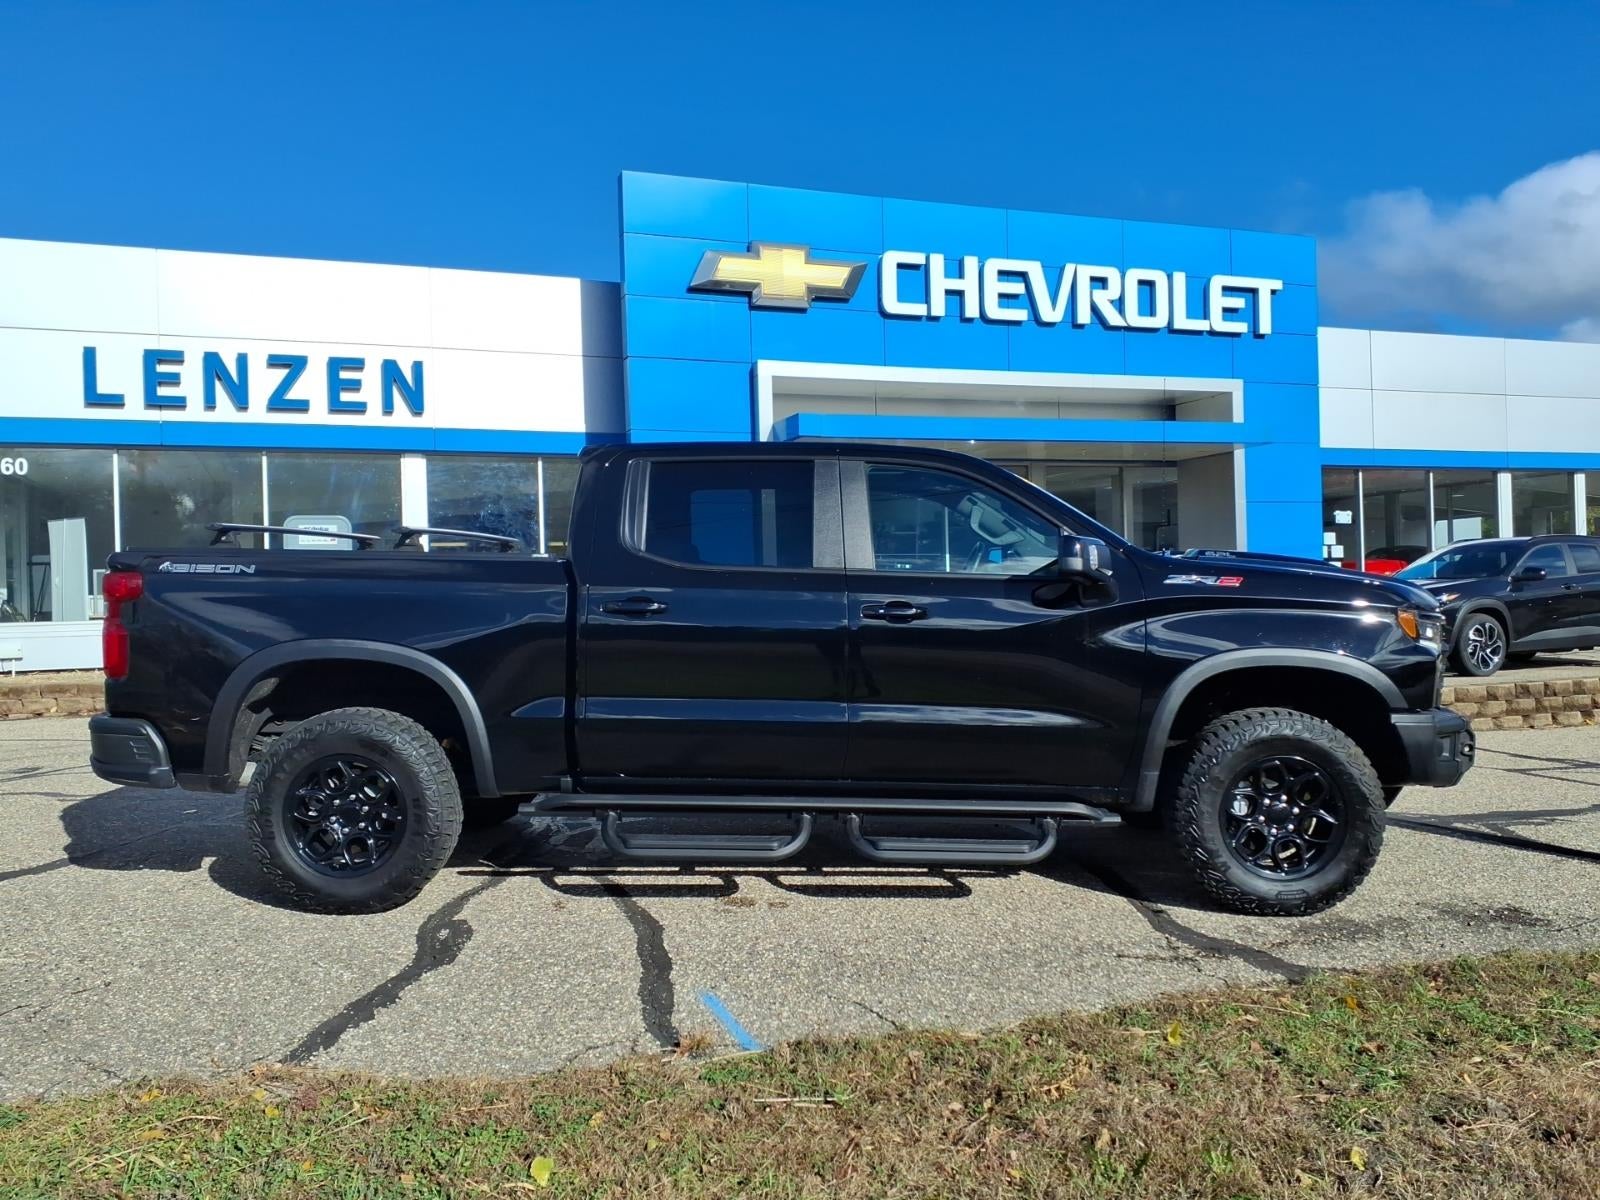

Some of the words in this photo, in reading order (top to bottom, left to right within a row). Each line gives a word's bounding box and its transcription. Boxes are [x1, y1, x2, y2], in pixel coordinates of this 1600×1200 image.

[879, 249, 1284, 335] CHEVROLET
[83, 345, 425, 416] LENZEN
[0, 457, 28, 476] 60
[172, 563, 256, 574] BISON
